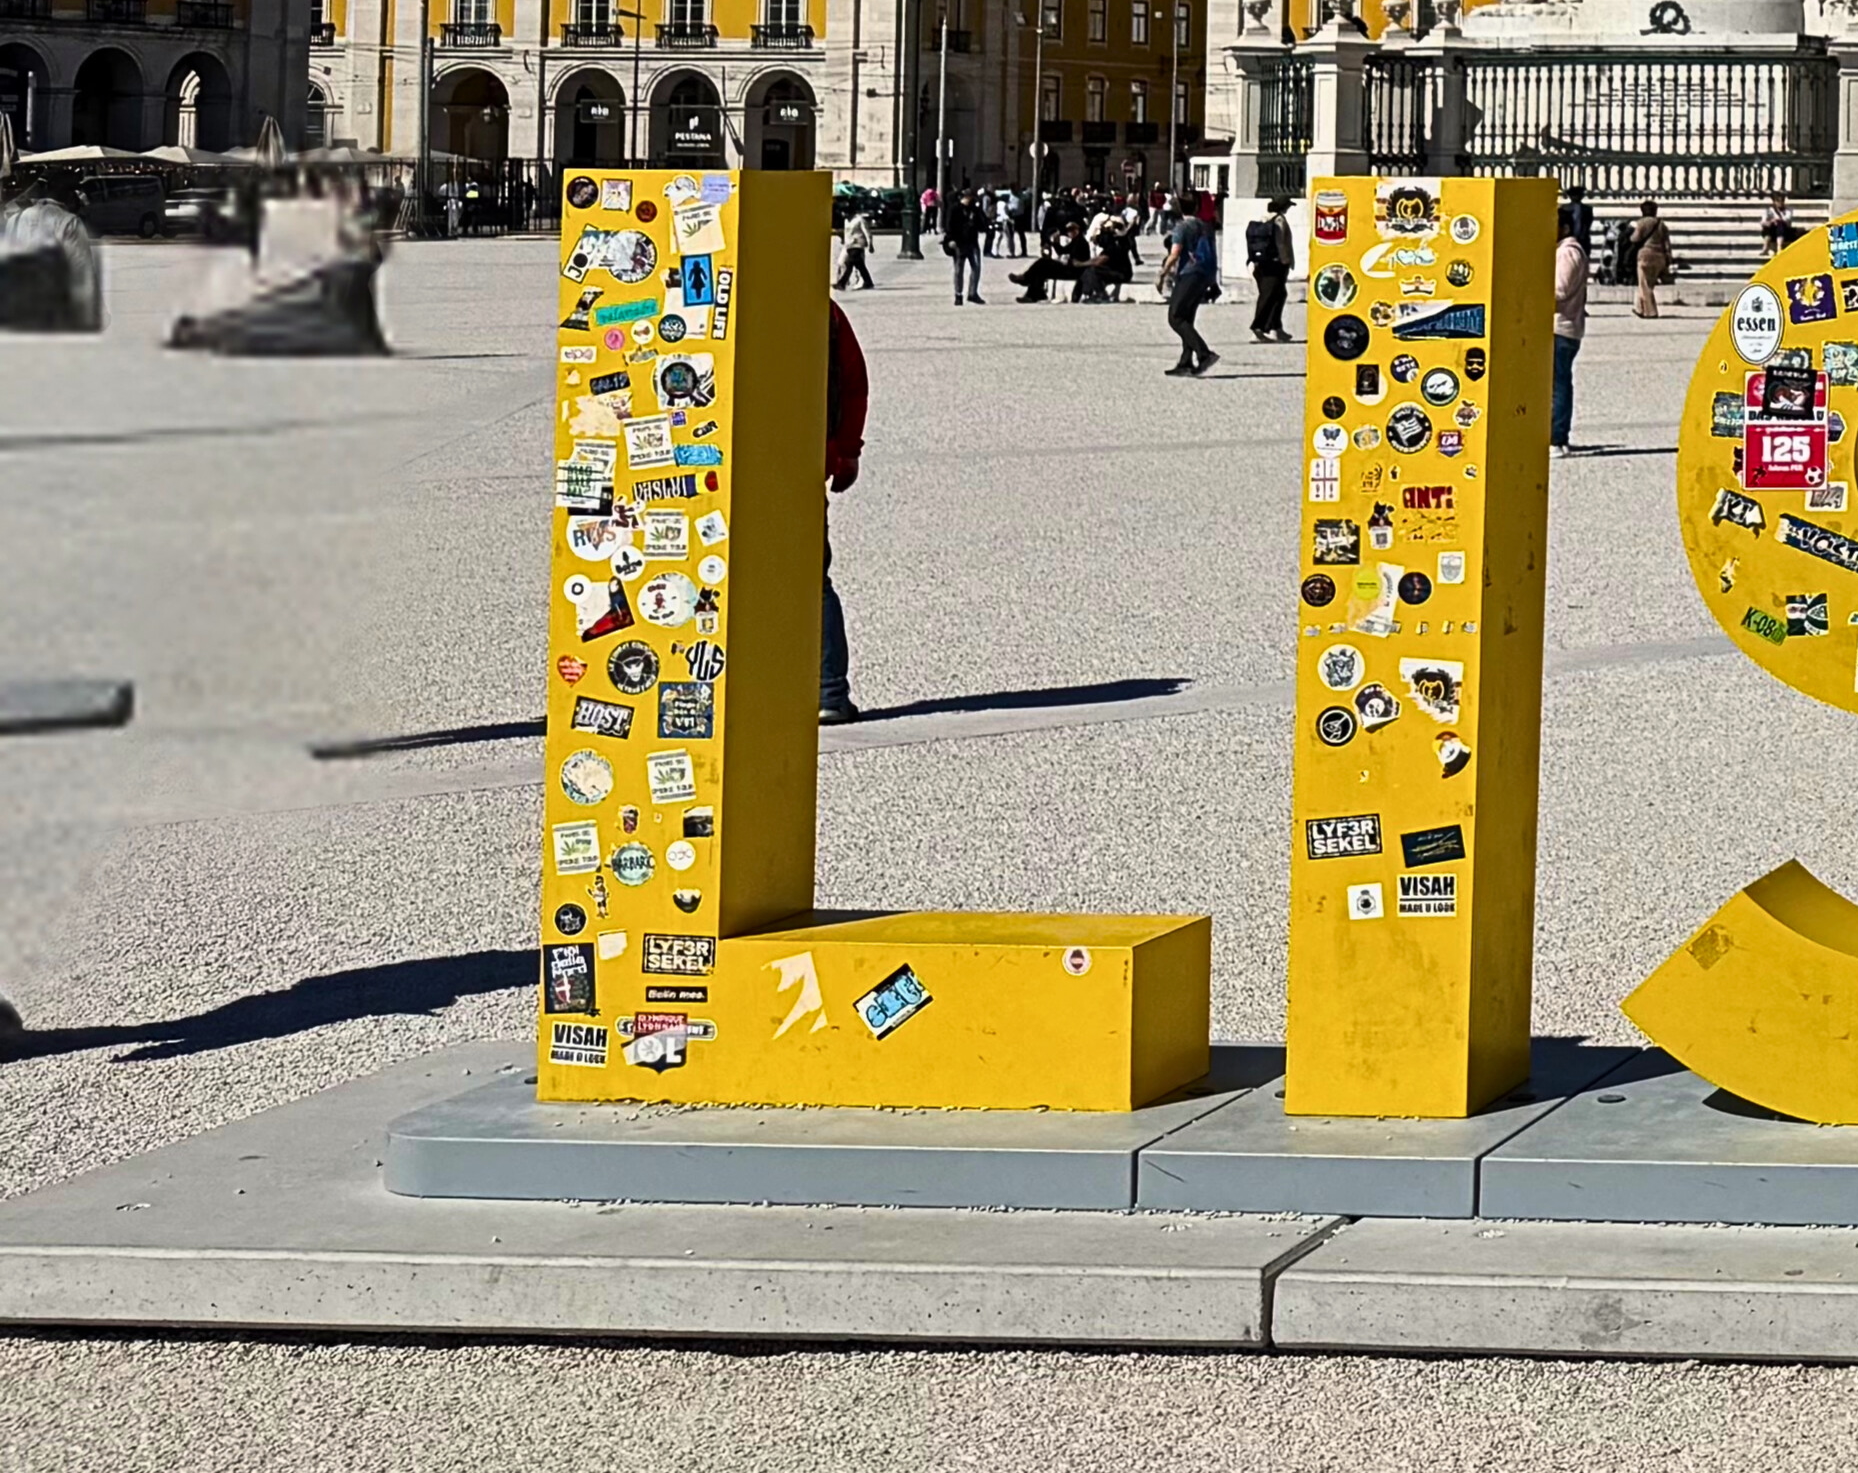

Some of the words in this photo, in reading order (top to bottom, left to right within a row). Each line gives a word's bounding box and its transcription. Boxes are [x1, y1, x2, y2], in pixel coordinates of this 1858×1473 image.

[675, 132, 712, 141] PESTANA
[1761, 436, 1811, 462] 125
[1312, 820, 1375, 839] LYF3R
[1314, 836, 1377, 854] SEKEL
[1400, 875, 1455, 896] VISAH
[648, 938, 711, 956] LYF3R
[648, 954, 708, 971] SEKEL
[554, 1024, 607, 1049] VISAH
